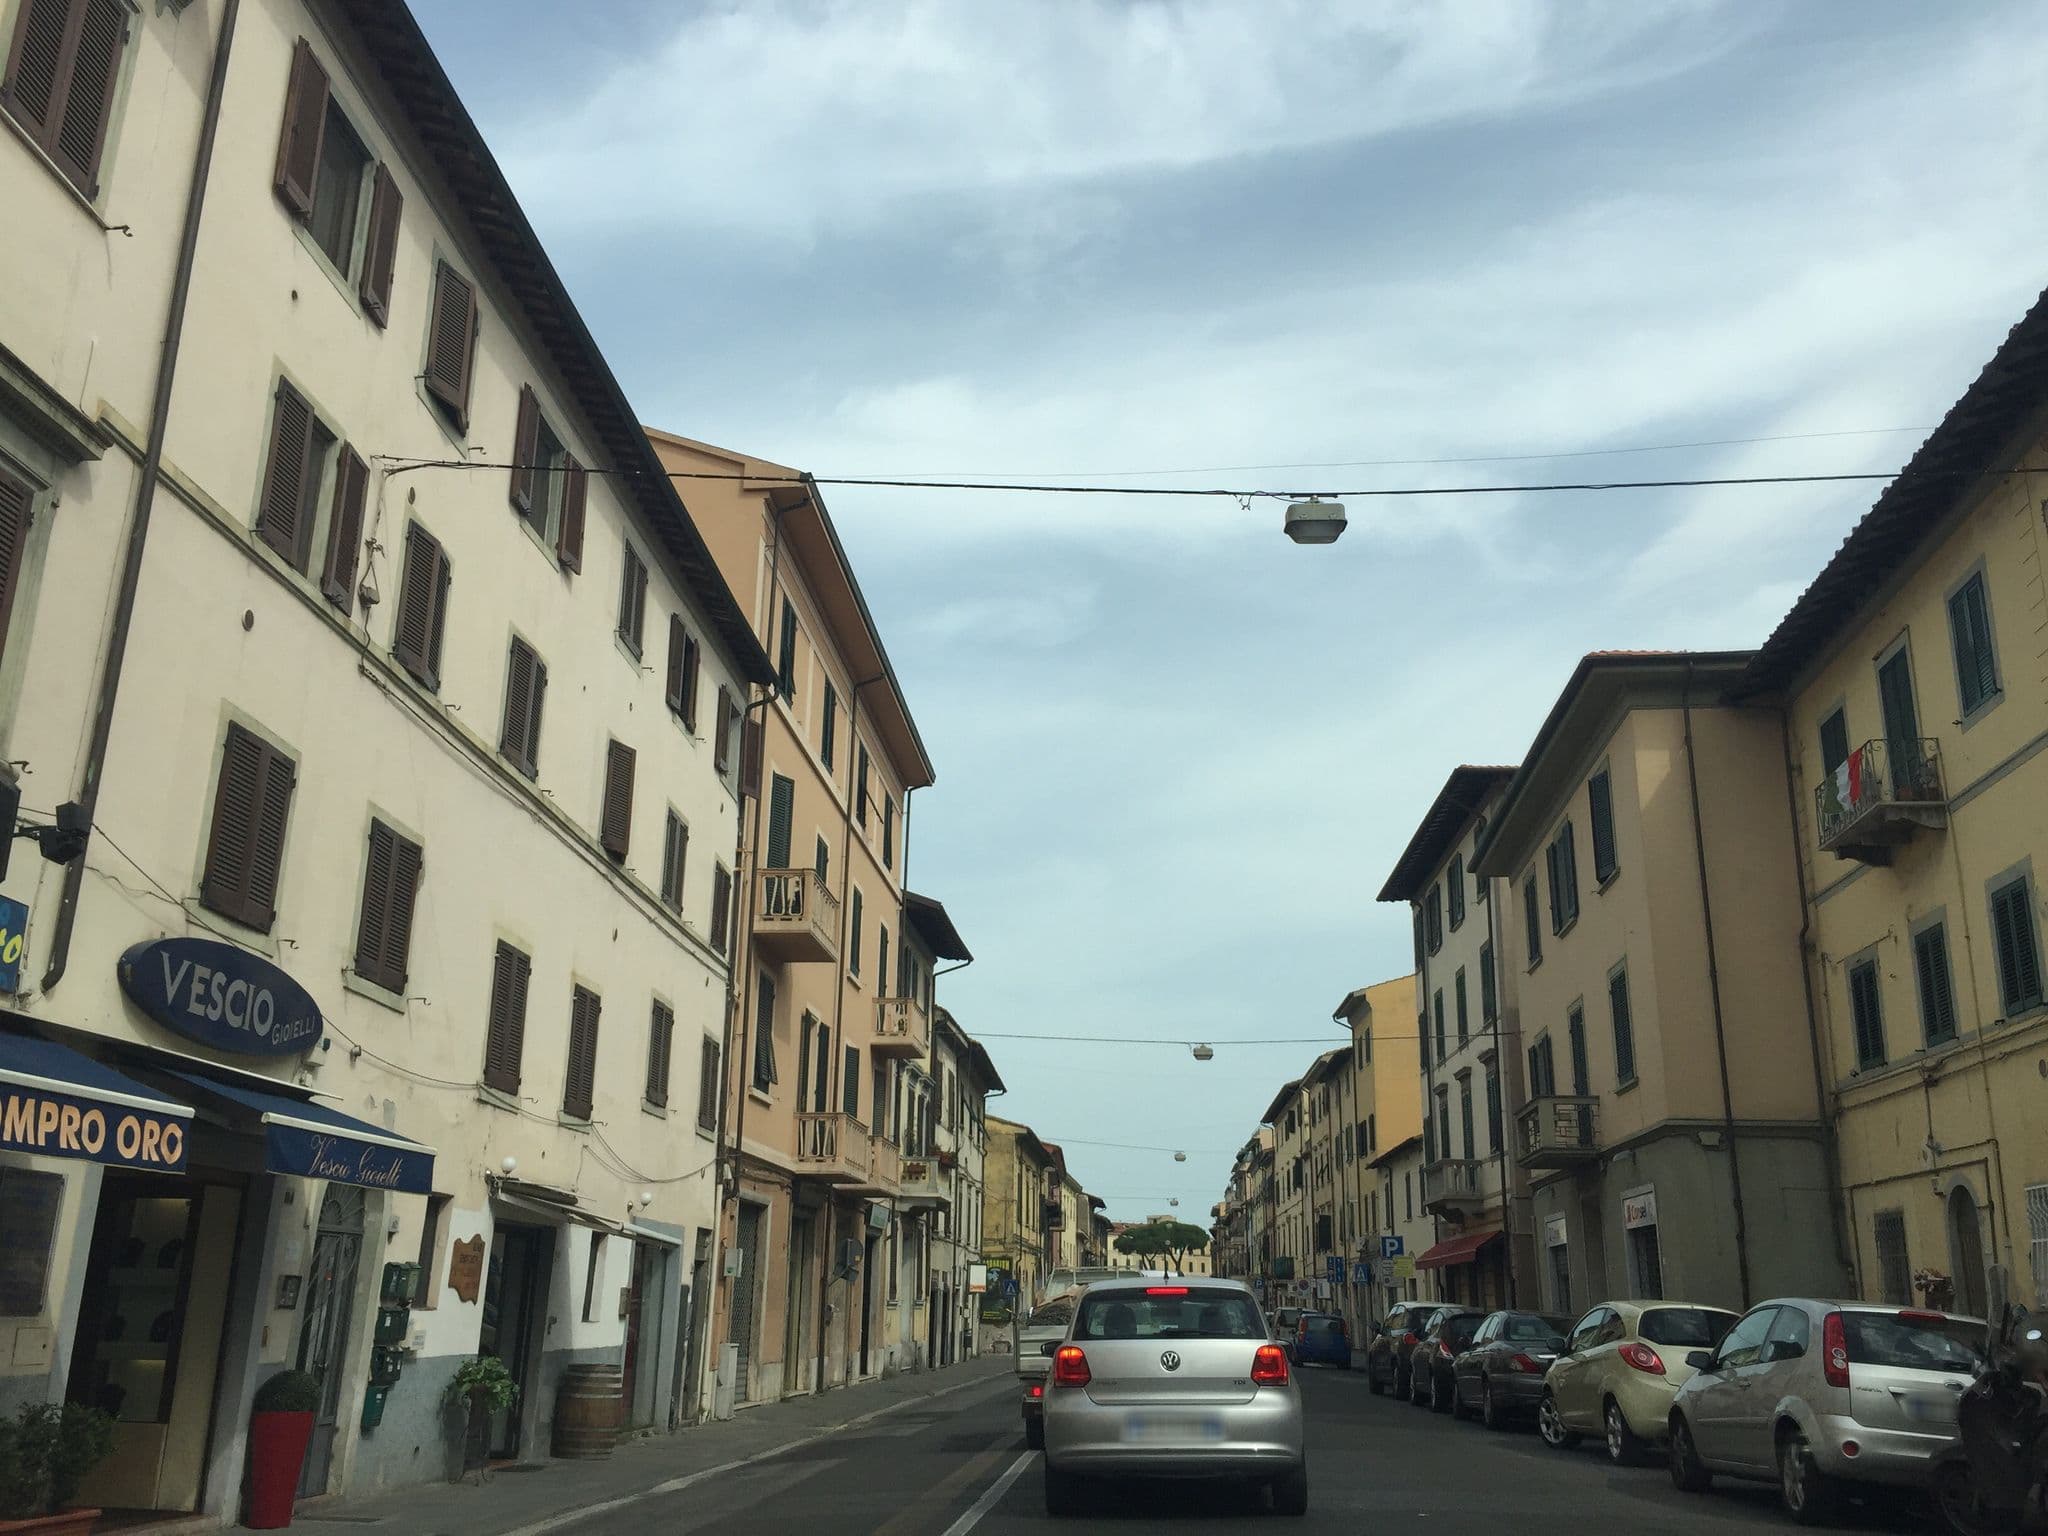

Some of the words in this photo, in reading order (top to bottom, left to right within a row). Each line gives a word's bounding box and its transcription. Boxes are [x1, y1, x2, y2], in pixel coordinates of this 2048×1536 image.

[160, 950, 274, 1036] VESCIO
[271, 1016, 316, 1045] GIOIELLI
[0, 1095, 106, 1153] MPRO
[117, 1115, 183, 1164] ORO
[1385, 1238, 1399, 1258] P
